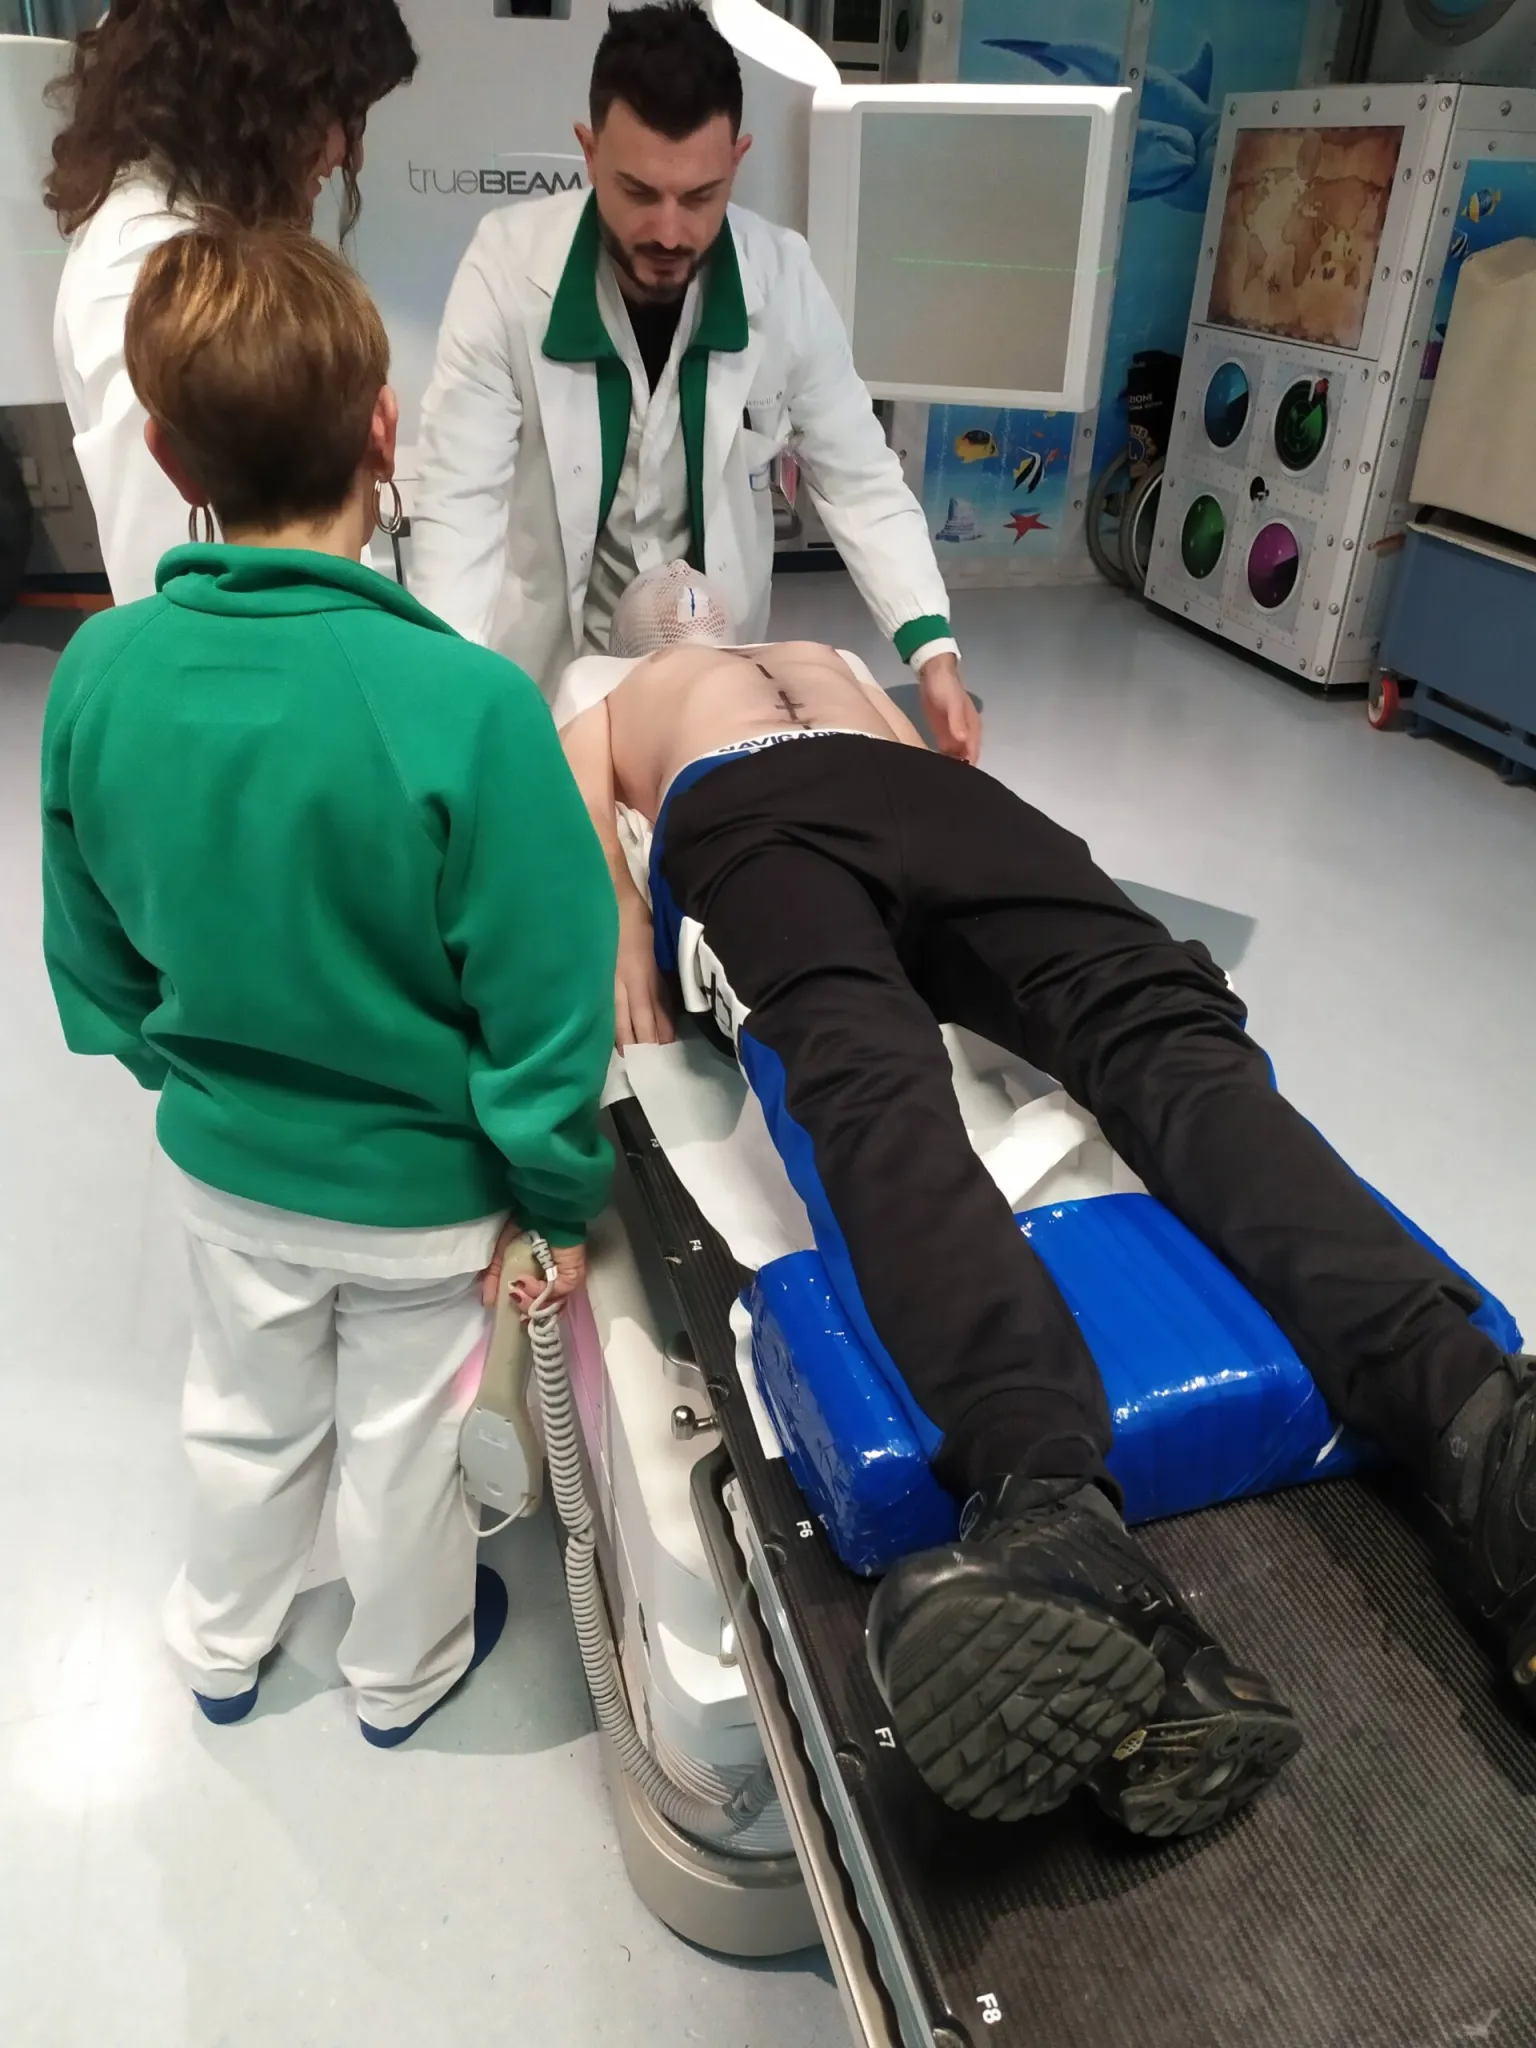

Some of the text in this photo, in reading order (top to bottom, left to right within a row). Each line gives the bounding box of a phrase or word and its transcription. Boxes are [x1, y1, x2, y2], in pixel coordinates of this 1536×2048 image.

[408, 159, 583, 195] trueBEAM
[688, 1239, 703, 1251] F4
[796, 1520, 814, 1538] F6
[874, 1726, 896, 1748] F7
[976, 1992, 1002, 2024] F8
